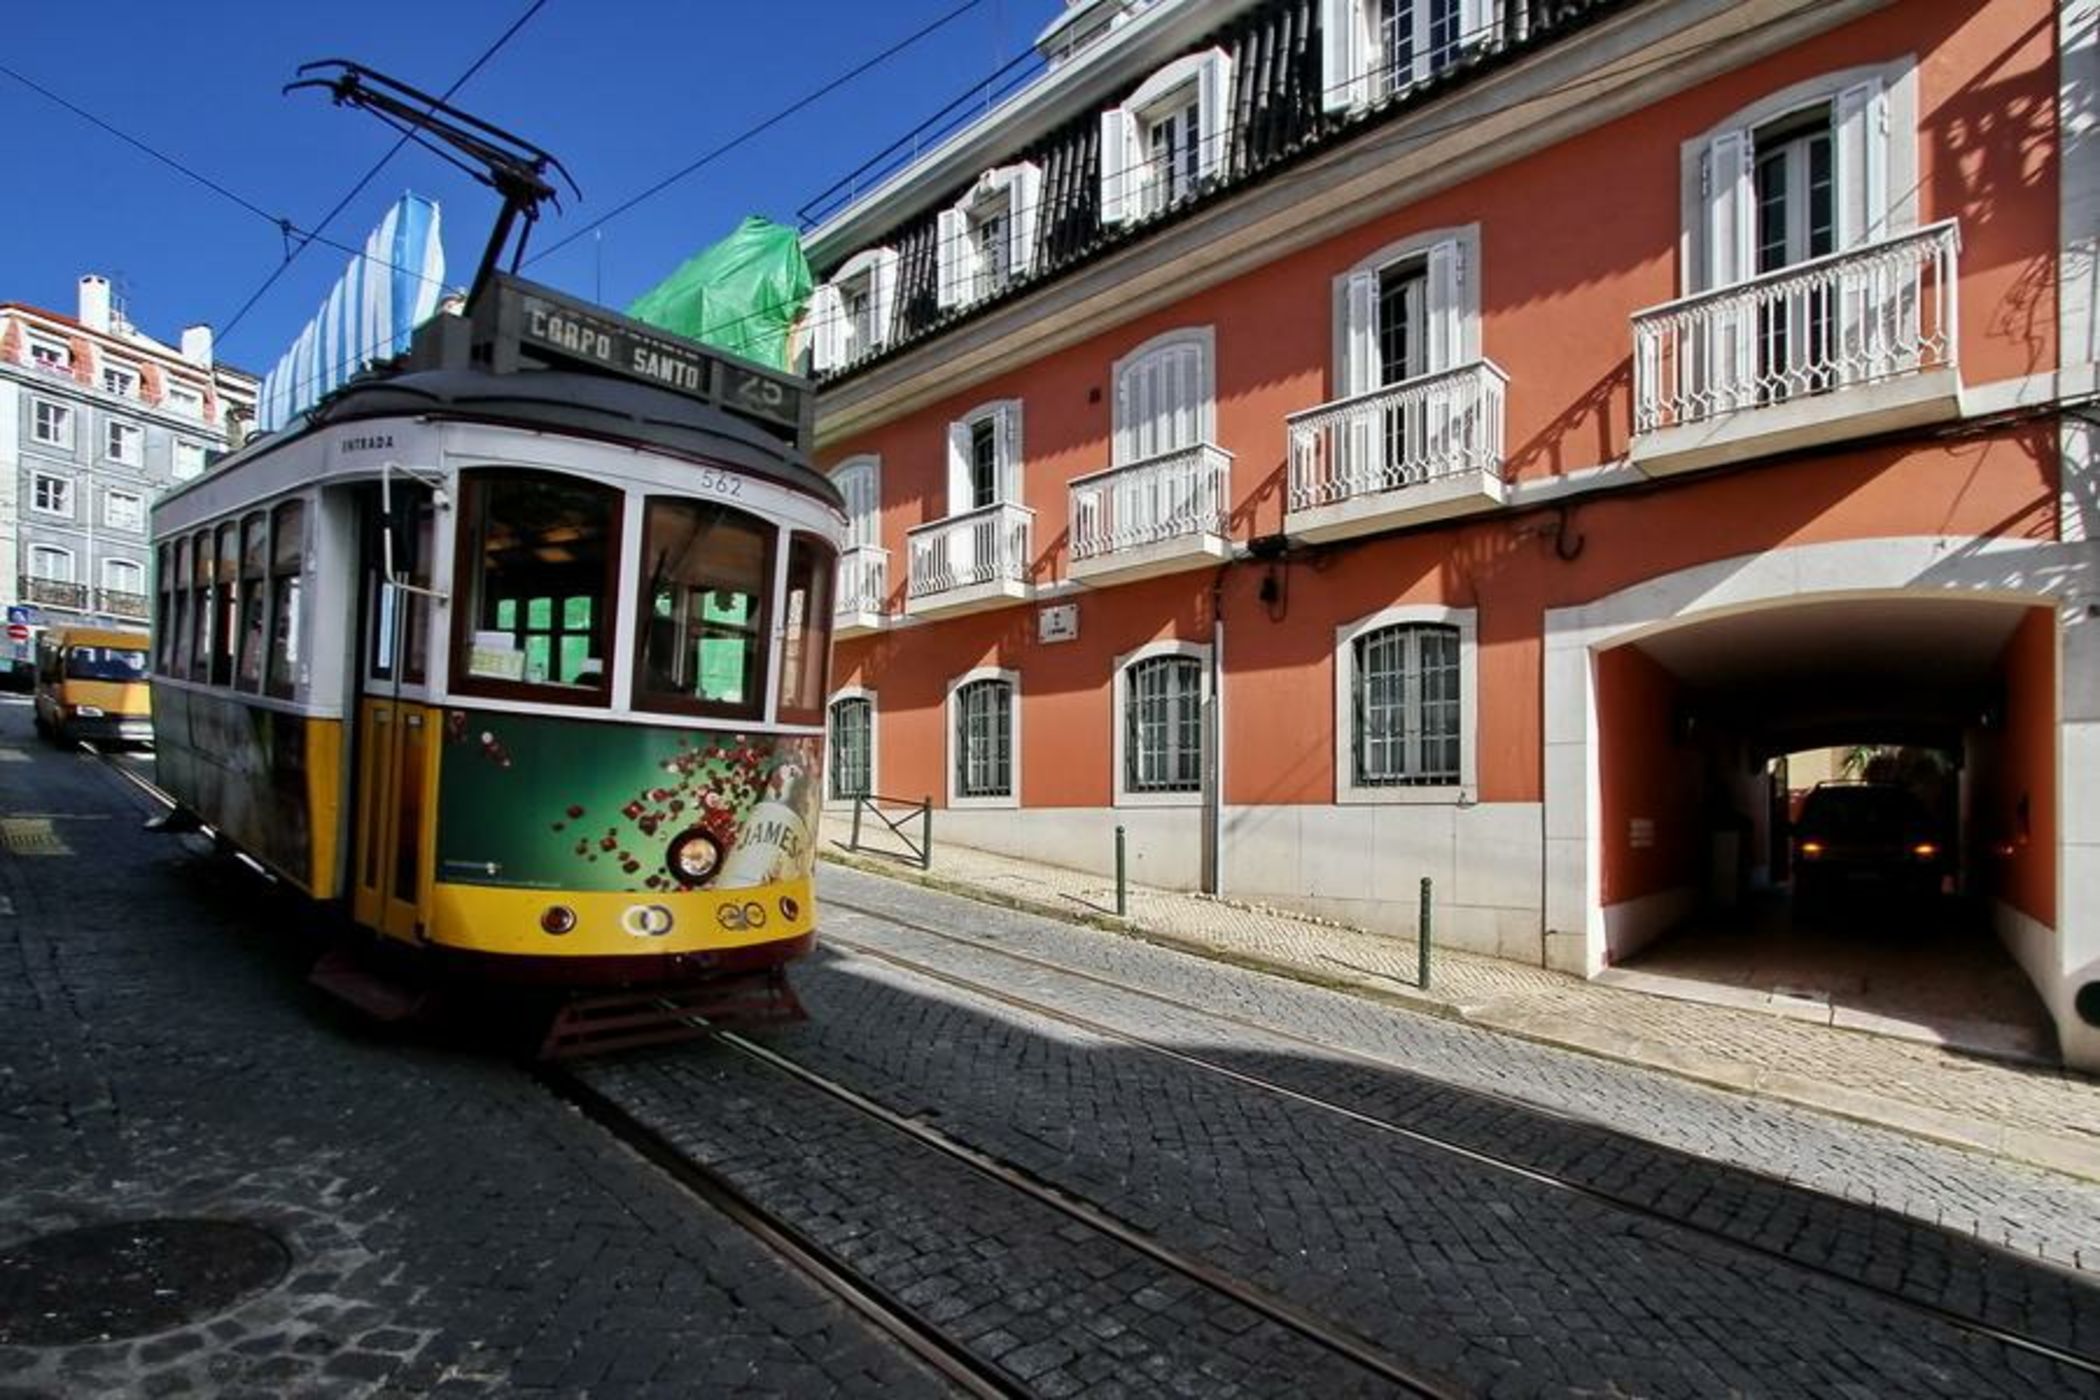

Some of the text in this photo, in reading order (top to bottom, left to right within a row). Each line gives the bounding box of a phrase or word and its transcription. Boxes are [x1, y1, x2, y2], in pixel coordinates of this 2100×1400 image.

[530, 309, 700, 390] CORPO SANTO
[341, 435, 393, 453] ENTRADA
[701, 469, 741, 497] 562
